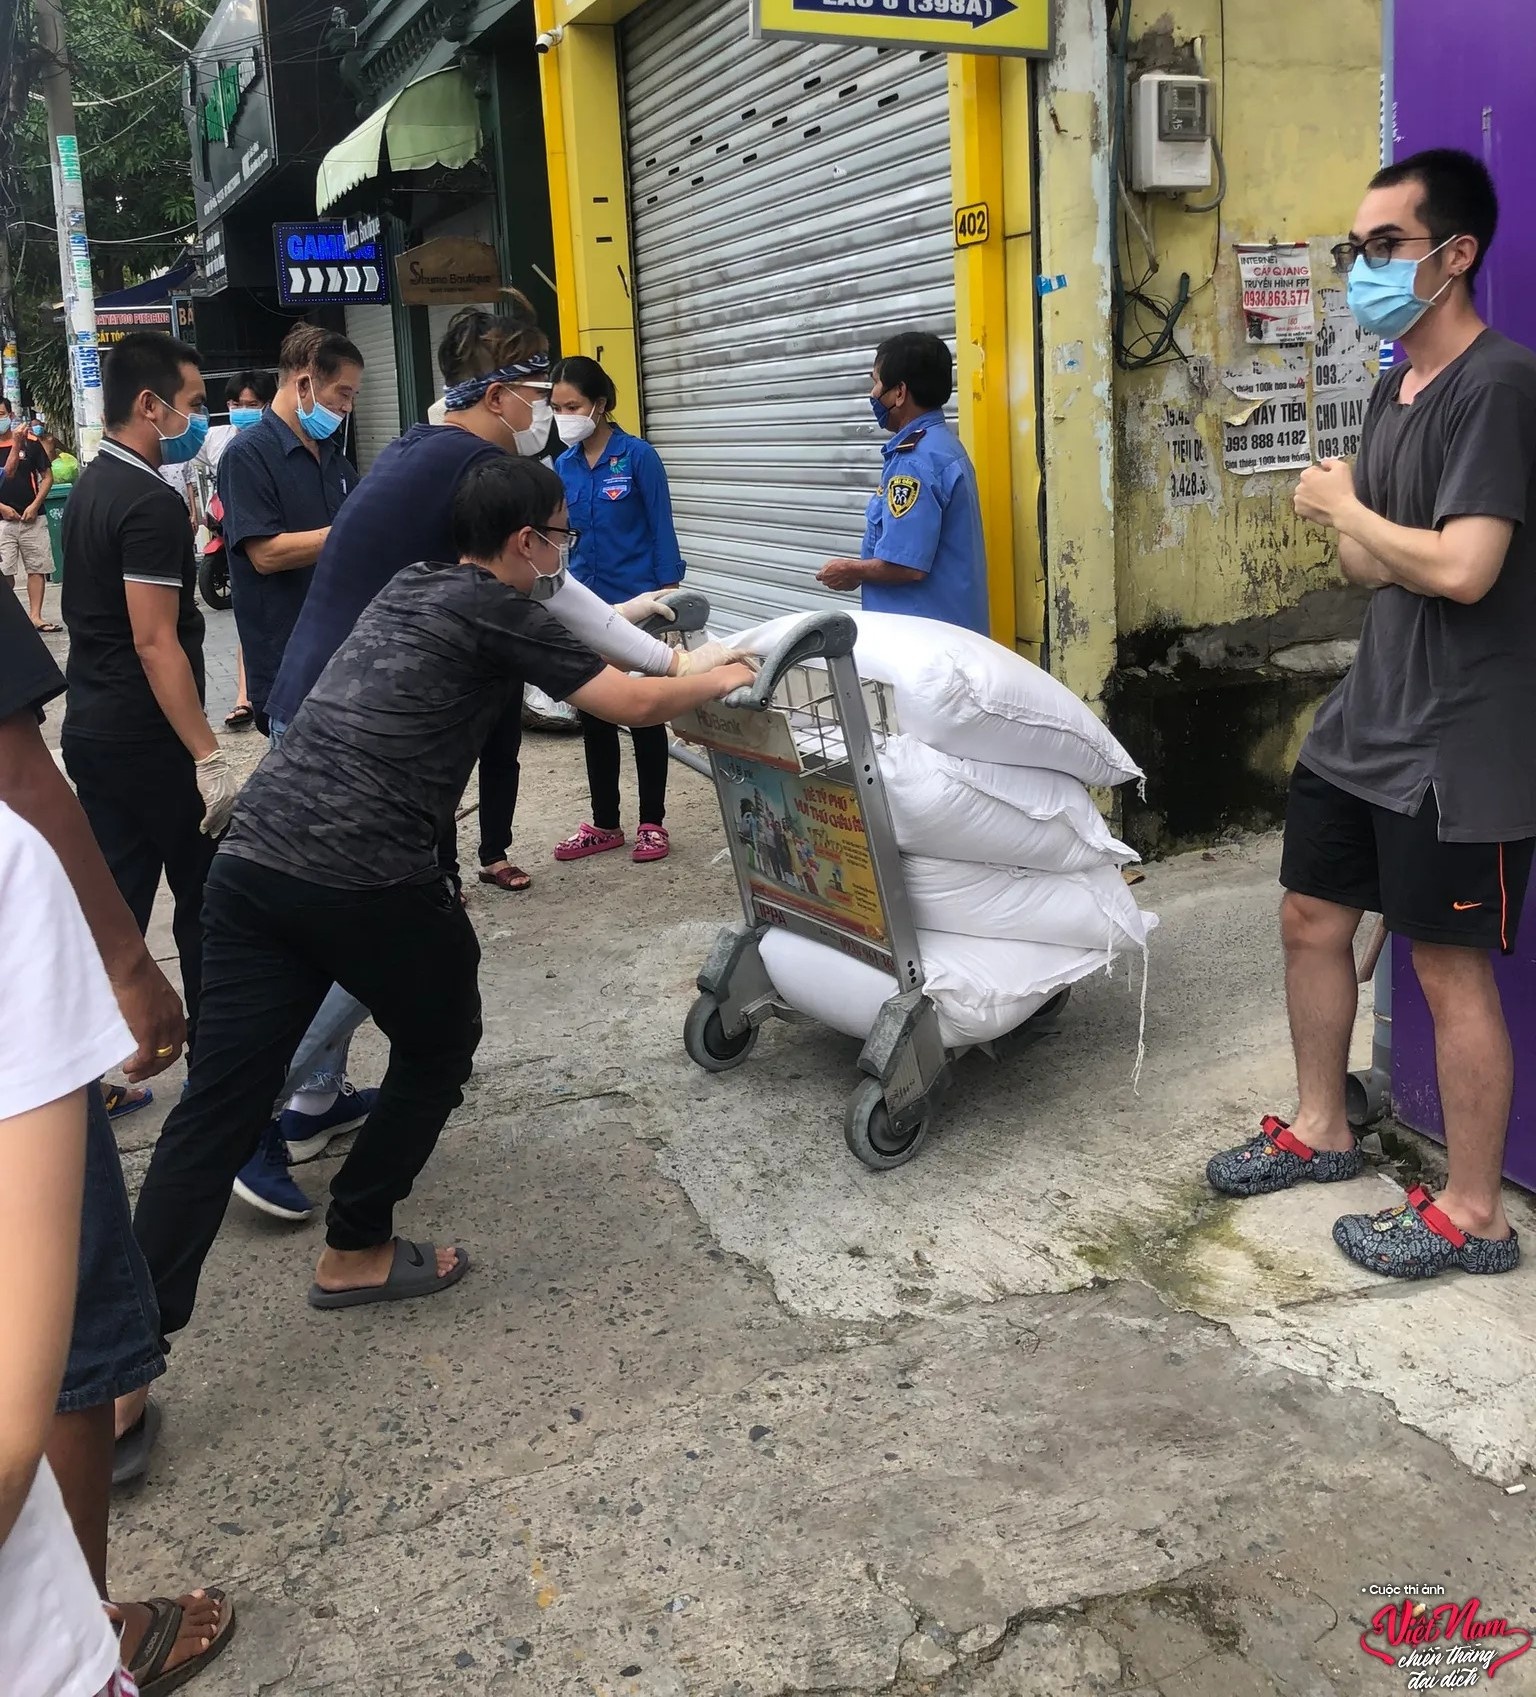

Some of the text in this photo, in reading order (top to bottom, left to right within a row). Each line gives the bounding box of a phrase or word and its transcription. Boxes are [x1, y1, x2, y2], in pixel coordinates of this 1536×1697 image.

[959, 211, 986, 237] 402
[1240, 255, 1278, 265] INTERNET
[1272, 266, 1309, 276] QUANG
[1274, 278, 1294, 288] HÌNH
[1296, 279, 1310, 288] FPT
[1244, 289, 1310, 307] 0938.863.577
[133, 312, 170, 325] PIERCING
[1316, 398, 1363, 432] CHO VAY
[1251, 432, 1273, 449] 888
[1277, 429, 1307, 446] 4182
